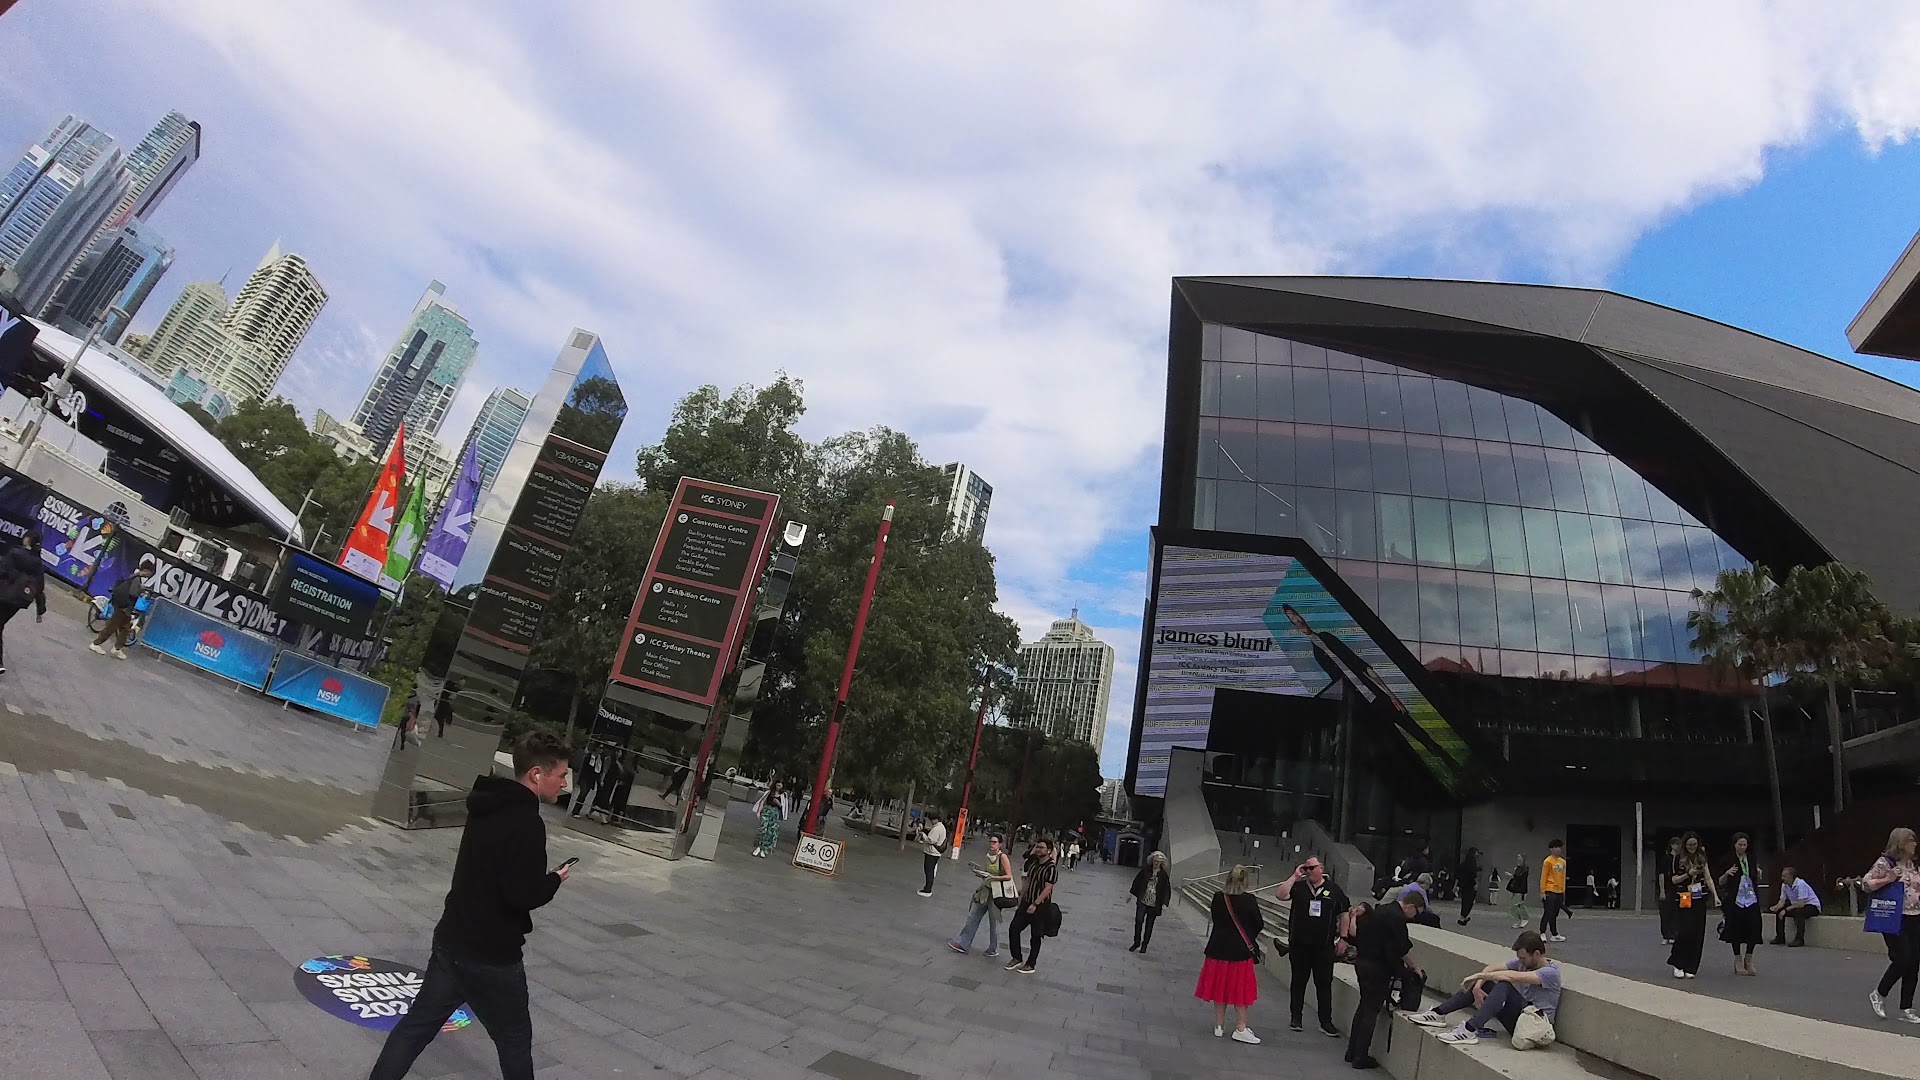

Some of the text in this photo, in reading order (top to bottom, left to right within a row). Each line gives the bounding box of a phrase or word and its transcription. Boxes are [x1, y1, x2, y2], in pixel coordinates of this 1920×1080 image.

[716, 498, 748, 510] SYDNEY
[37, 507, 78, 536] SYDNEY
[692, 518, 748, 534] Convention Centre
[290, 579, 352, 610] REGISTRATION
[667, 587, 720, 605] Exhibition Centre
[228, 595, 287, 635] SYDNEY
[1157, 626, 1272, 651] james blunt
[195, 642, 221, 658] NSW
[650, 638, 711, 659] ICC Sydney Theatre
[654, 662, 669, 670] Office
[317, 689, 340, 703] NSW
[822, 848, 832, 858] 10
[317, 972, 399, 988] SXSW
[332, 983, 423, 1002] SYDNE
[350, 1000, 409, 1019] 202
